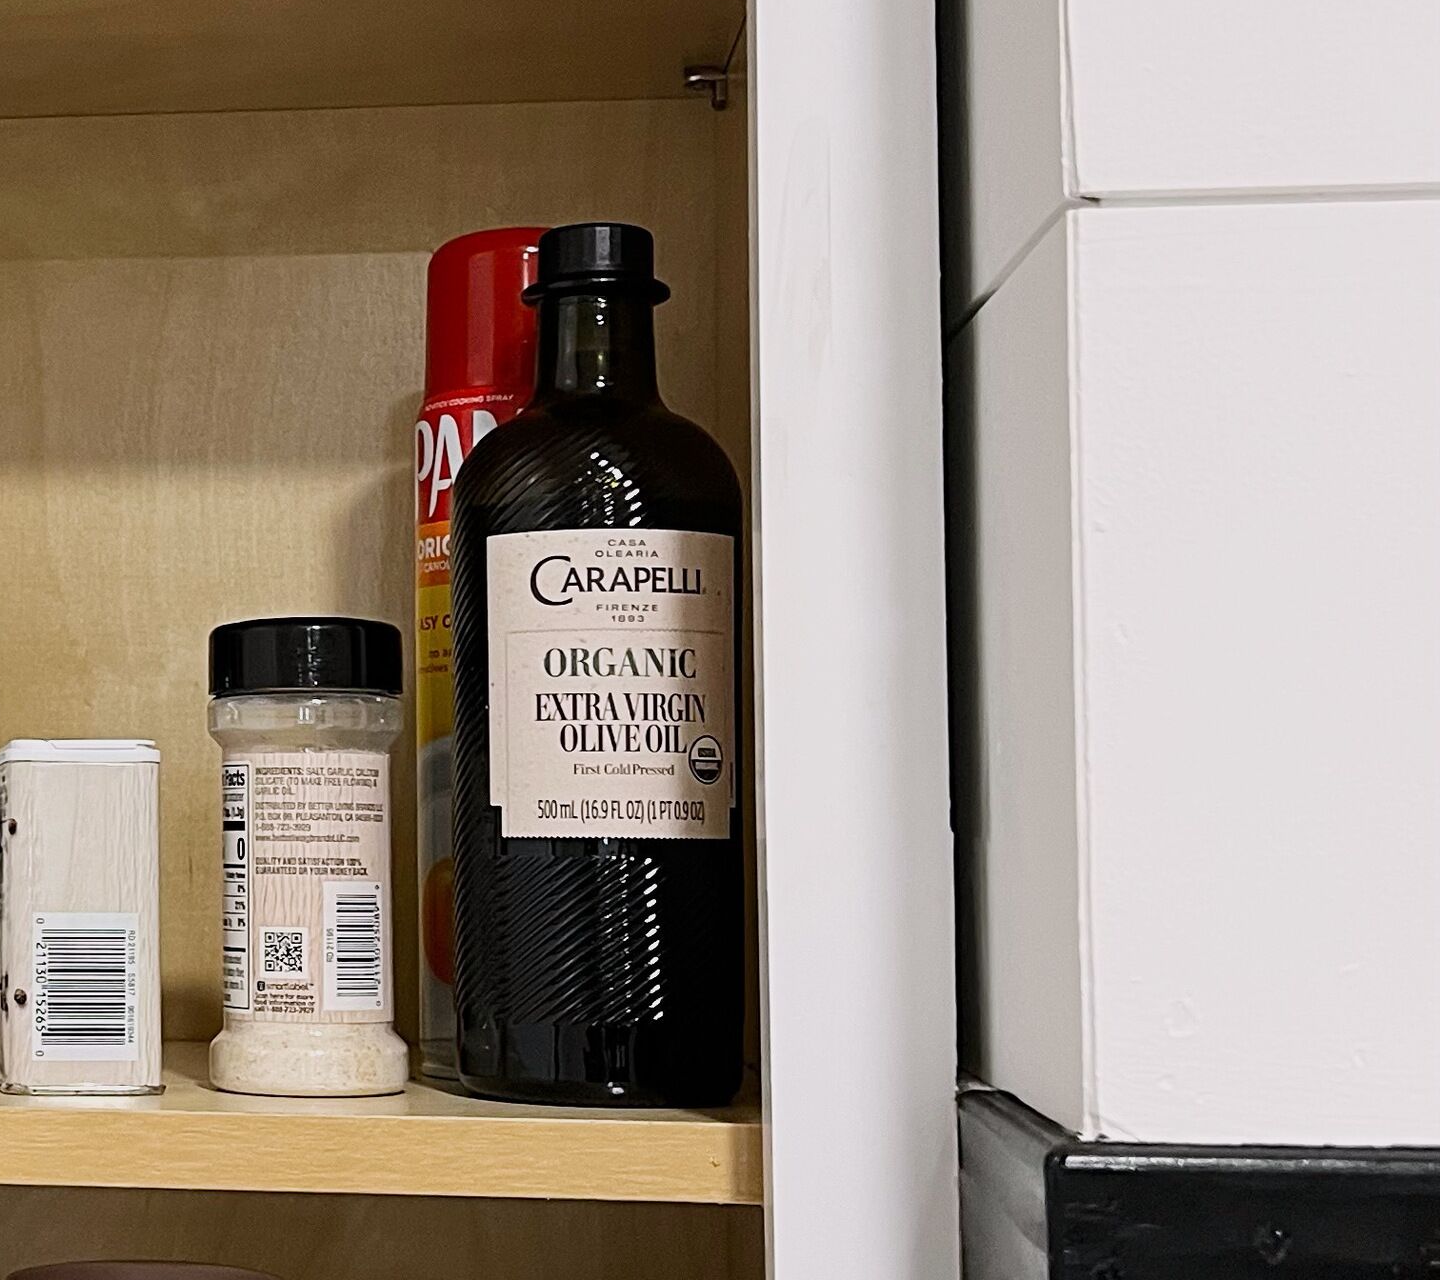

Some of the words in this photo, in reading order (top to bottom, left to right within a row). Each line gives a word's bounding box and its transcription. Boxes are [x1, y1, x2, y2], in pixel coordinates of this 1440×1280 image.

[486, 394, 515, 403] SPRAY
[418, 534, 451, 561] ORIG
[594, 549, 660, 558] OLEARIA
[607, 538, 647, 547] CASA
[530, 555, 701, 606] CARAPELLI
[596, 604, 659, 612] FIRENZE
[611, 615, 646, 623] 1893
[543, 647, 697, 679] ORGANIC
[535, 691, 621, 722] EXTRA
[622, 692, 706, 724] VIRGIN
[560, 723, 641, 753] OLIVE
[645, 723, 688, 754] OIL
[573, 763, 601, 775] First
[603, 763, 631, 775] Cold
[632, 763, 675, 776] Pressed
[537, 799, 558, 819] 500
[559, 800, 578, 819] mL
[580, 798, 609, 824] (16.9
[611, 800, 624, 819] FL
[626, 799, 645, 824] OZ)
[647, 799, 657, 824] (1
[659, 801, 673, 820] PT
[674, 801, 689, 821] 0.9
[689, 802, 705, 825] OZ)
[237, 837, 245, 860] 0
[127, 930, 136, 940] RD
[35, 942, 47, 984] 21130
[326, 952, 334, 963] RD
[35, 991, 46, 1032] 15265
